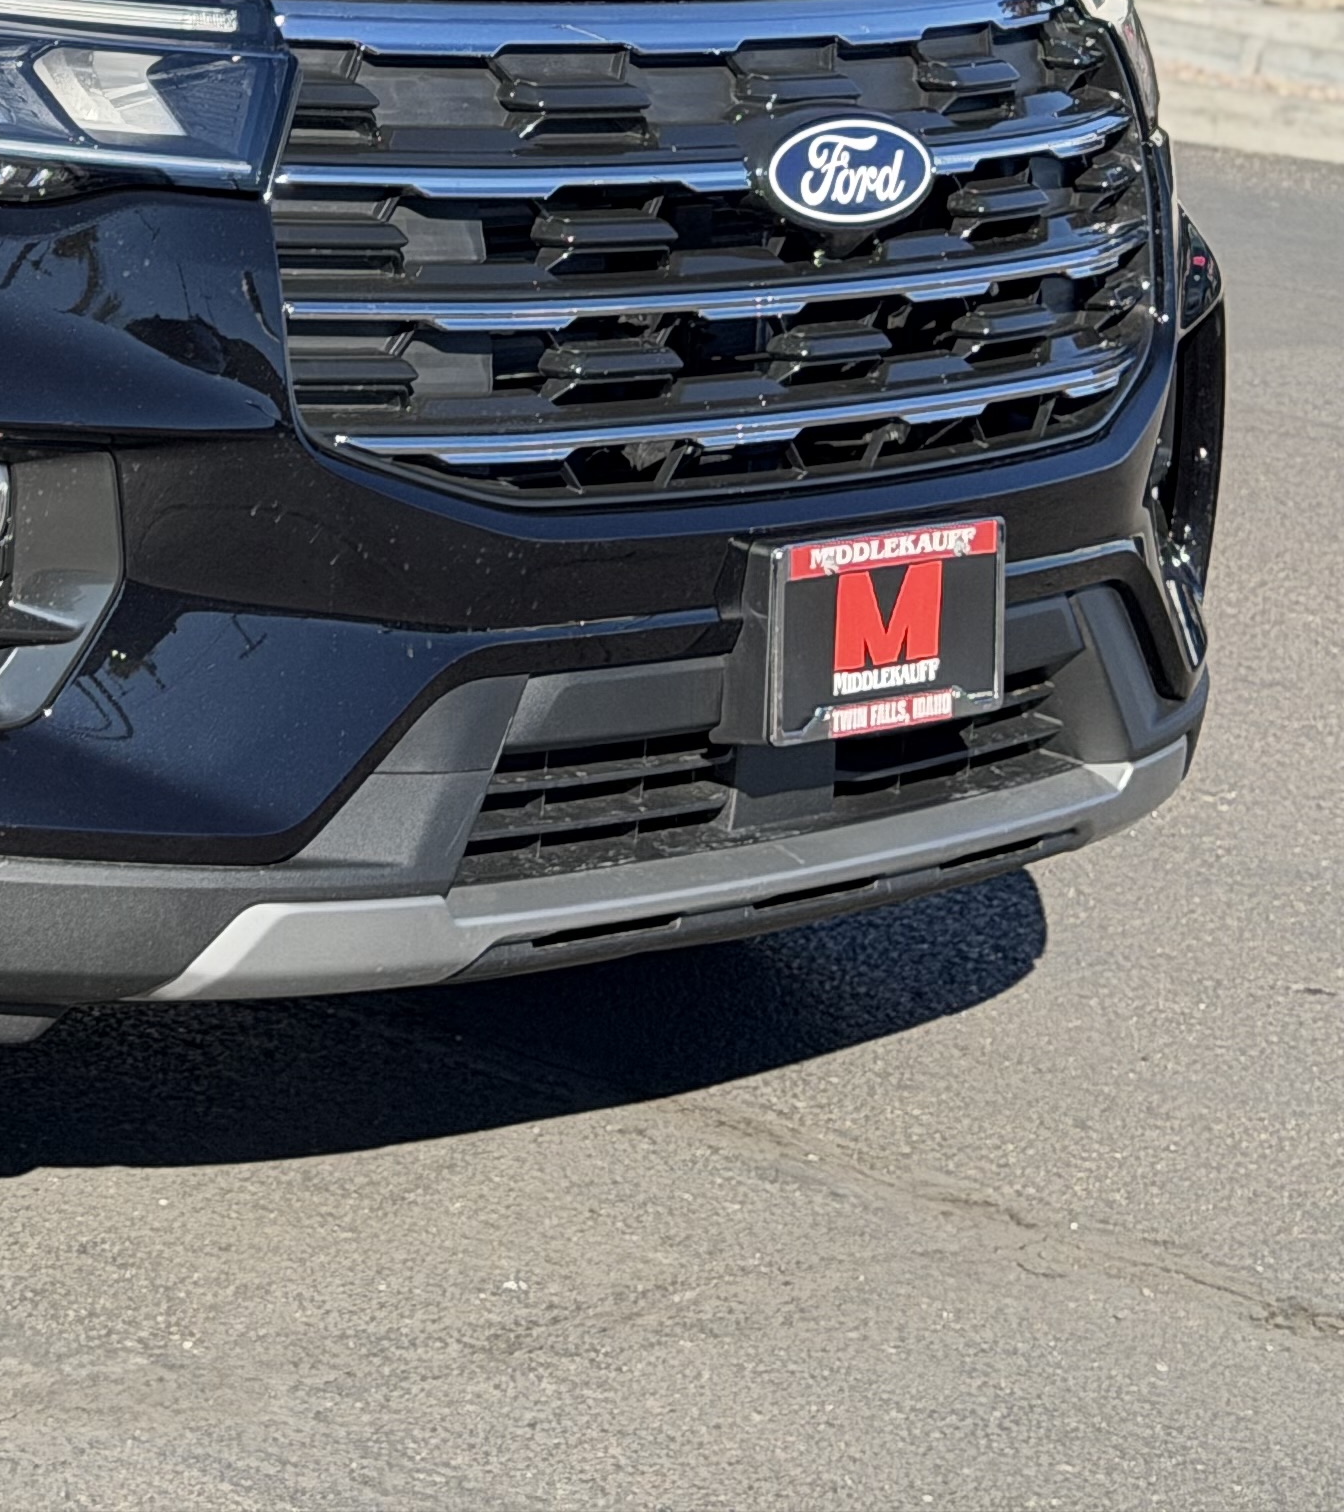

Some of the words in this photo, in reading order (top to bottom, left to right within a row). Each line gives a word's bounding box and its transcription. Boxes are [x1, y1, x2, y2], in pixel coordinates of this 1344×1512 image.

[800, 134, 907, 206] Ford
[833, 560, 942, 671] M
[833, 658, 940, 696] MIDDLEKAUFF
[832, 705, 868, 732] TWIN
[870, 699, 910, 726] FALLS,
[912, 692, 952, 719] IDAHO
